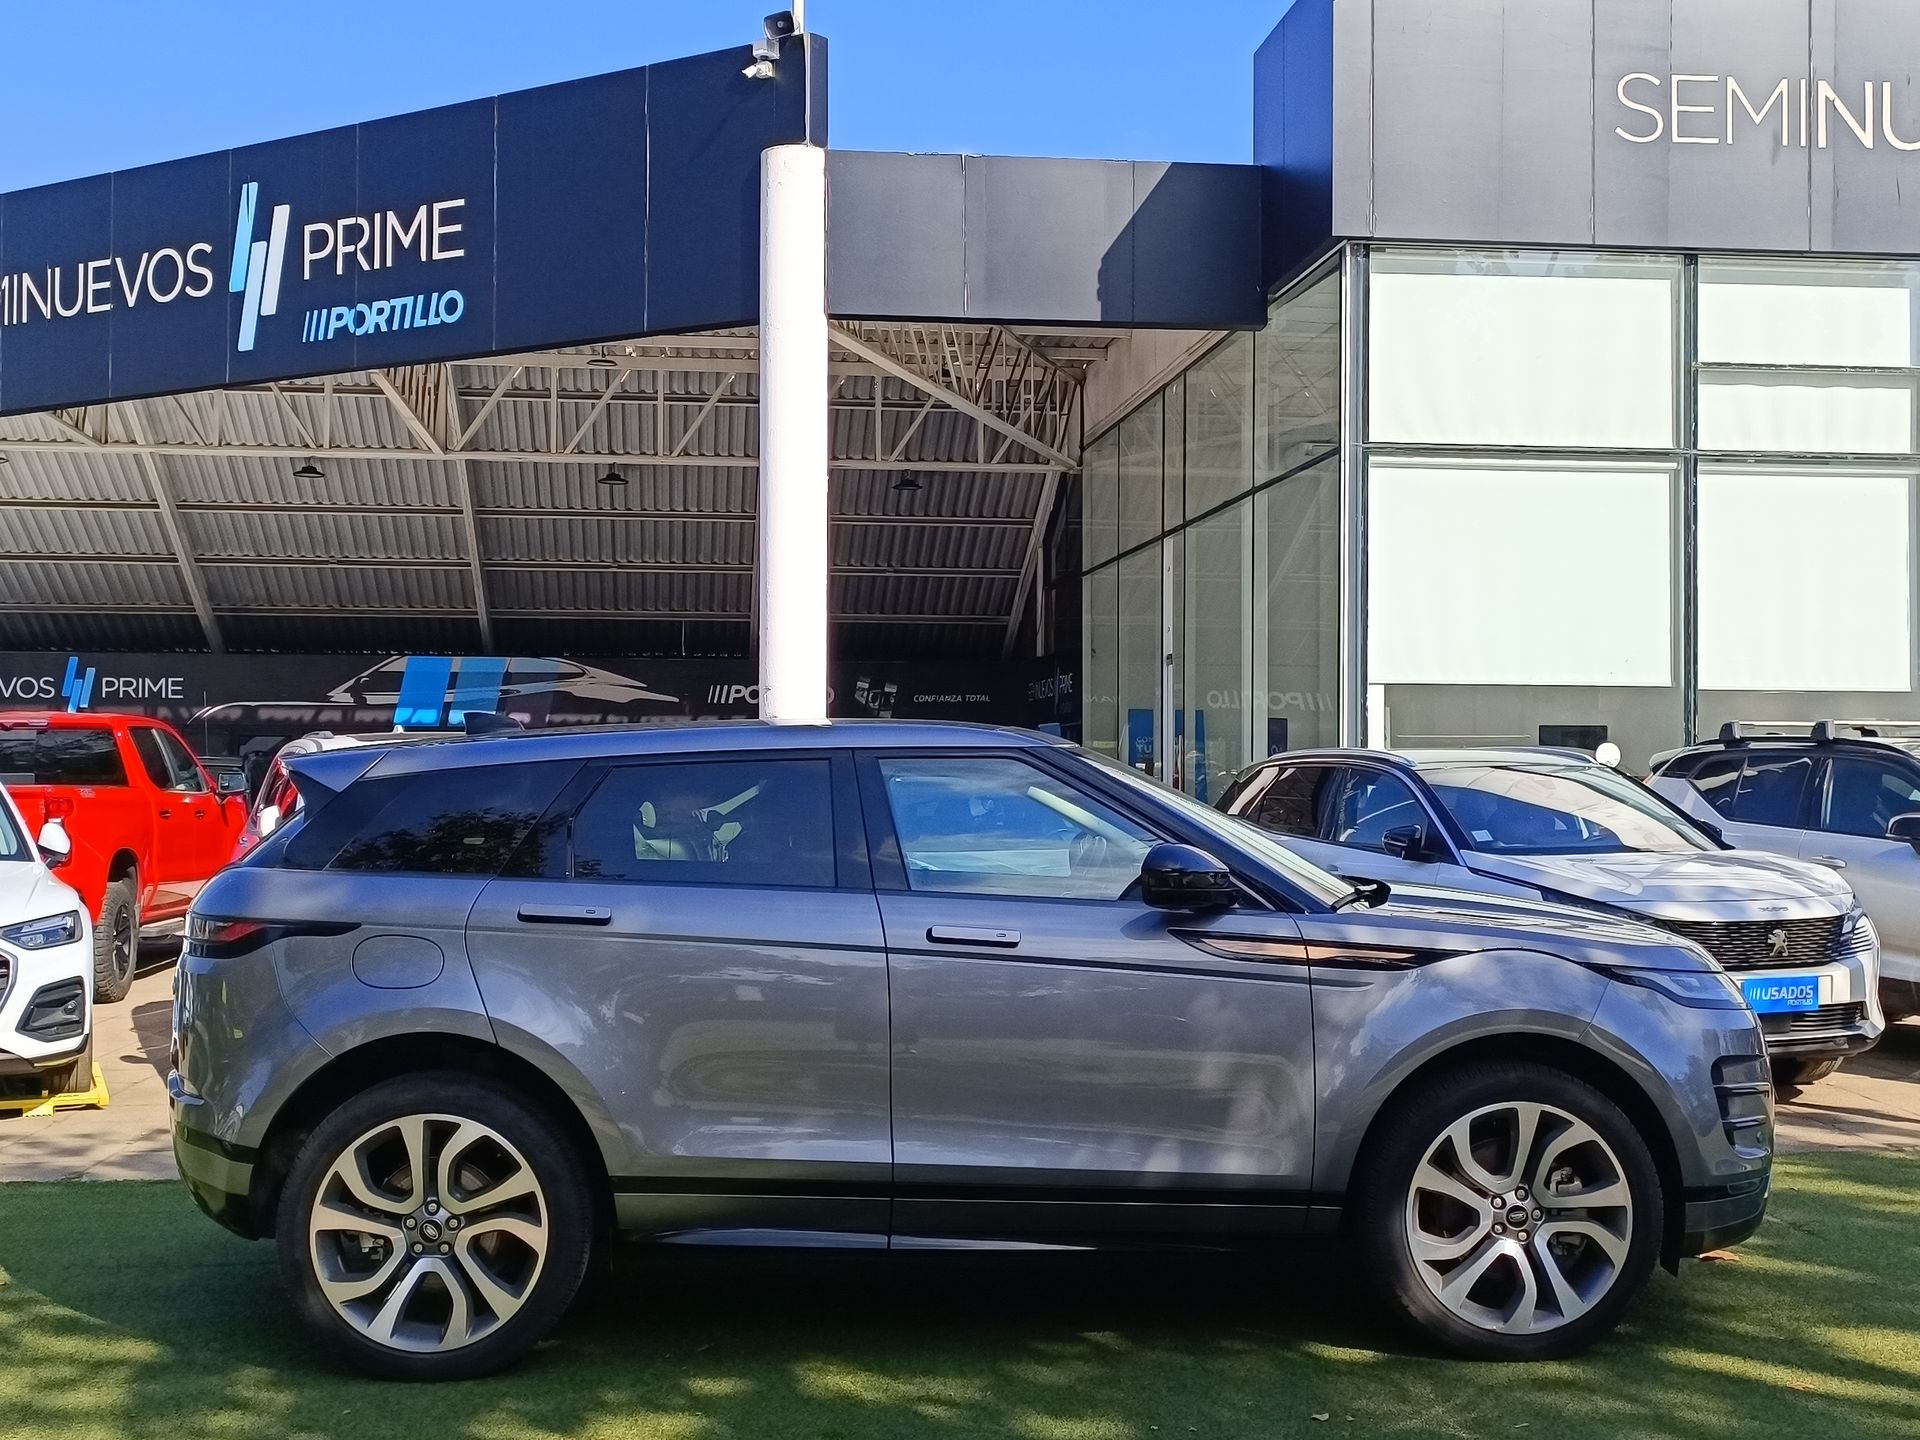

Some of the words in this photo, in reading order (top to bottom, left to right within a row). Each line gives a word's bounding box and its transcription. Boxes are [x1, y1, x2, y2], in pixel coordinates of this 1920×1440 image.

[1614, 71, 1920, 150] SEMINU
[303, 198, 465, 280] PRIME
[327, 289, 465, 339] PORTILLO
[101, 677, 184, 699] PRIME
[913, 694, 962, 703] CONFIANZA
[965, 694, 991, 702] TOTAL
[1761, 985, 1814, 1000] USADOS
